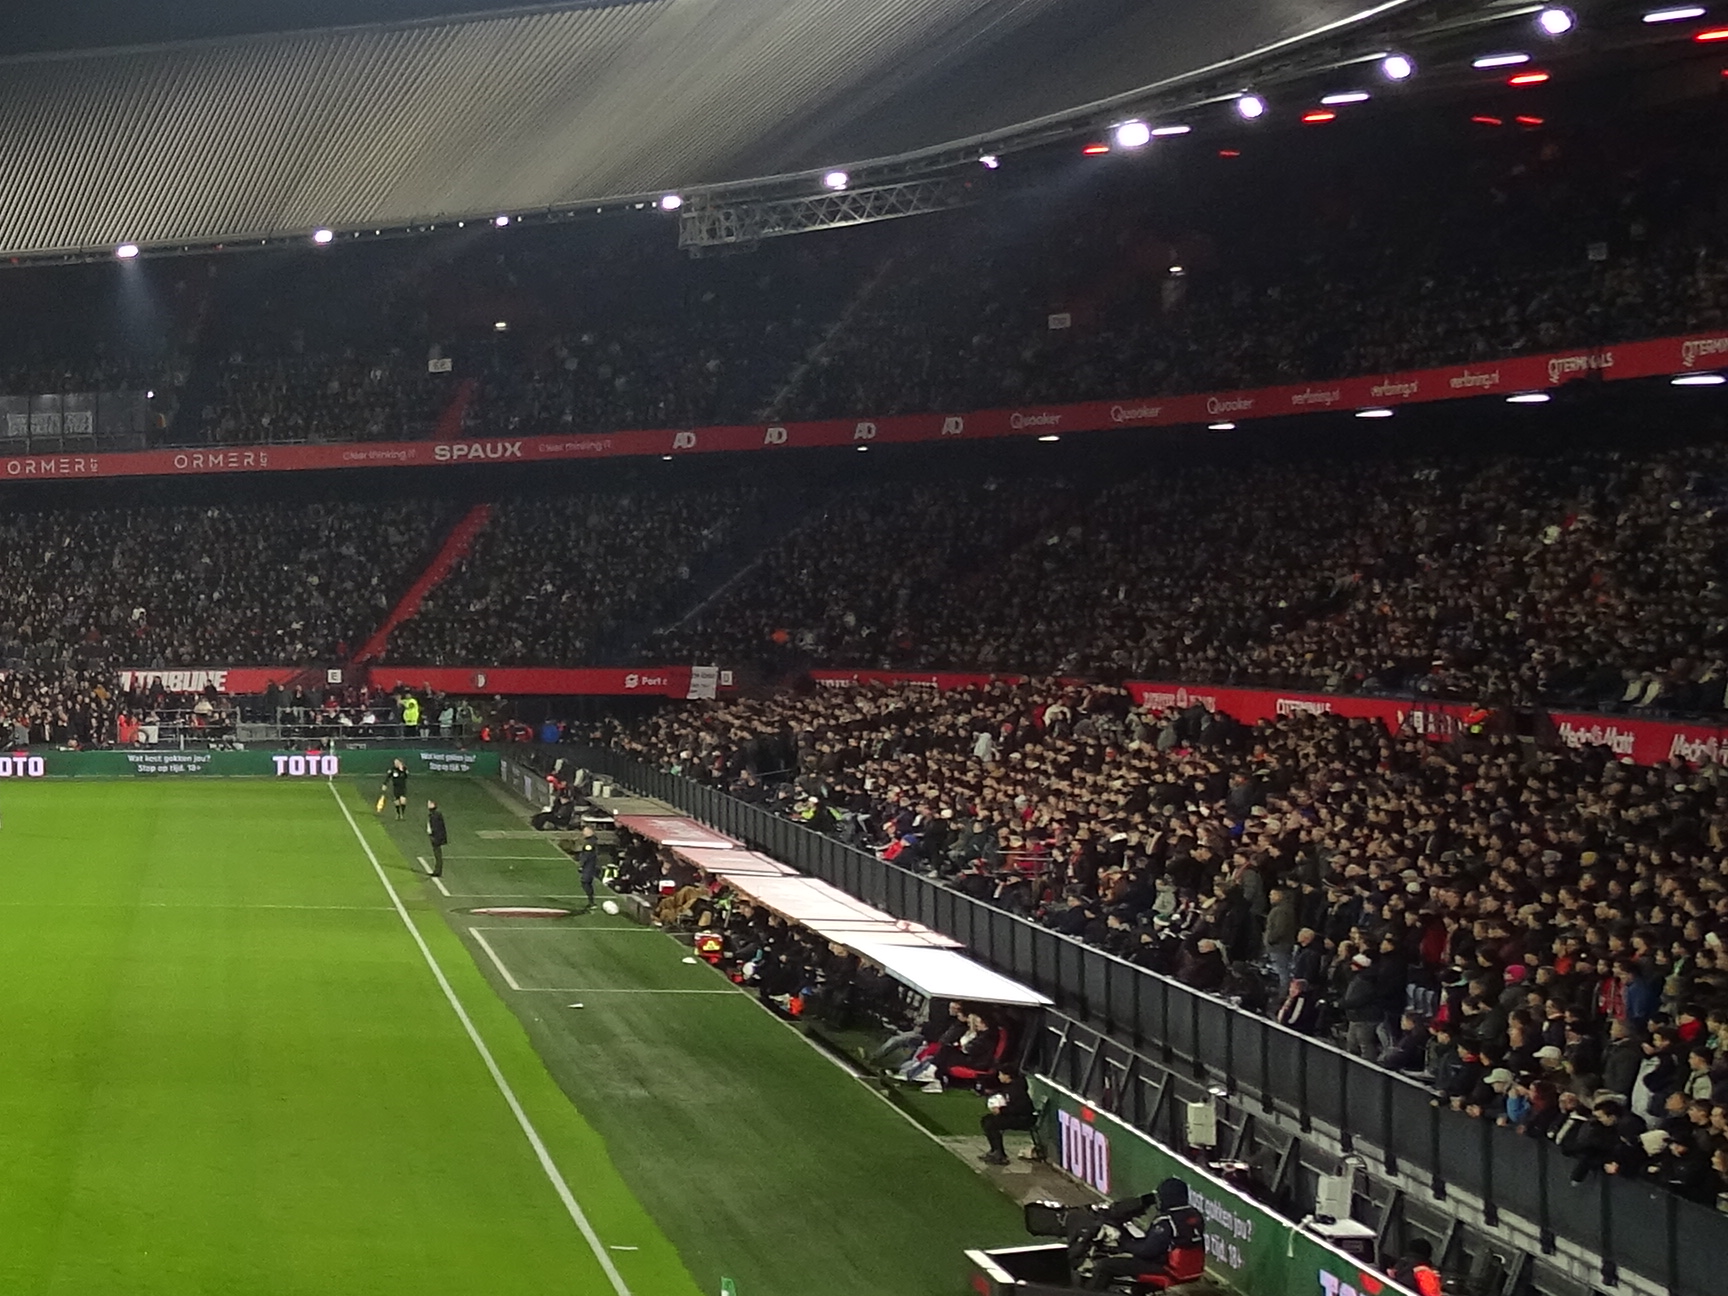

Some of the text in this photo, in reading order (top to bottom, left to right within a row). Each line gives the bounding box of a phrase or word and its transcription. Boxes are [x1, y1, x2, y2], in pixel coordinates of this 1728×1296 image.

[174, 453, 254, 469] ORMER
[434, 442, 522, 461] SPAUX
[7, 459, 85, 475] ORMER
[272, 755, 339, 776] TOTO
[1057, 1108, 1110, 1195] TOTO
